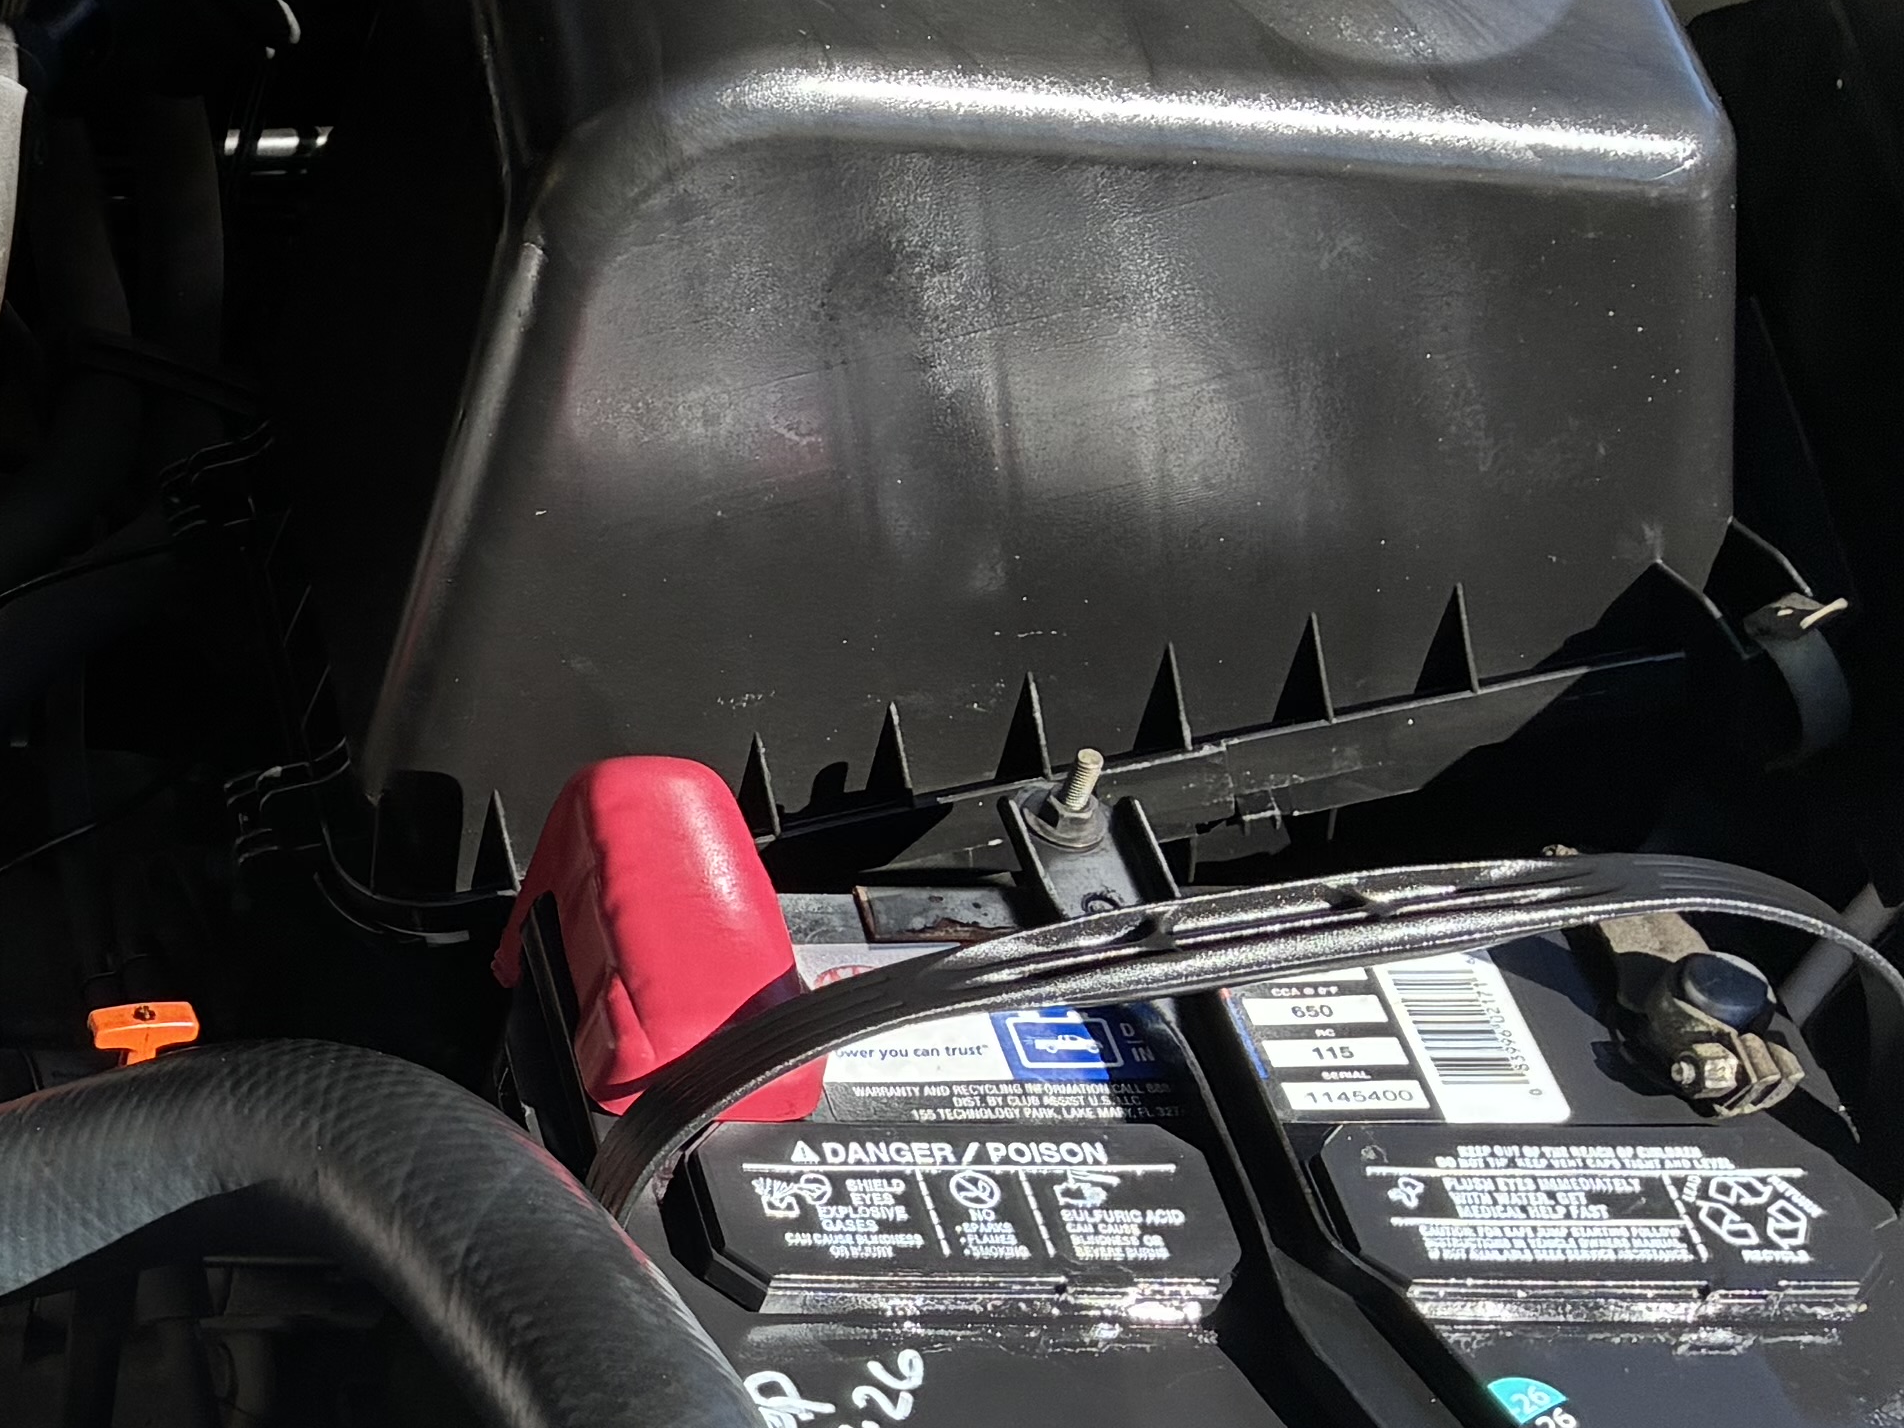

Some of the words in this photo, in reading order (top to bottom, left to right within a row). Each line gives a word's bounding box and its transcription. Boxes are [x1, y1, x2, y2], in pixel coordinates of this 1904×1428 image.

[1291, 1004, 1334, 1019] 650
[833, 1044, 876, 1061] ower
[879, 1045, 910, 1061] you
[913, 1047, 940, 1059] can
[1312, 1047, 1354, 1061] 115
[1321, 1070, 1372, 1081] SERIAL
[852, 1084, 920, 1098] WARRANTY
[923, 1084, 950, 1098] AND
[953, 1084, 1022, 1098] RECYCLING
[1025, 1084, 1109, 1098] INFORMATION
[1111, 1083, 1144, 1095] CALL
[1305, 1090, 1414, 1105] 1145400
[912, 1108, 935, 1120] 155
[938, 1108, 1021, 1120] TECHNOLOGY
[1024, 1108, 1058, 1120] PARK,
[1063, 1108, 1096, 1120] LAKE
[1138, 1107, 1152, 1118] FL
[821, 1142, 955, 1164] DANGER
[985, 1141, 1108, 1165] POISON
[845, 1178, 906, 1194] SHIELD
[1442, 1177, 1495, 1192] FLUSH
[1495, 1177, 1537, 1192] EYES
[1537, 1177, 1641, 1193] IMMEDIATELY
[850, 1192, 896, 1206] EYES
[1448, 1192, 1493, 1205] WITH
[1556, 1192, 1587, 1205] GET
[816, 1205, 910, 1221] EXPLOSIVE
[968, 1209, 996, 1222] NO
[1060, 1208, 1143, 1224] SULFURIC
[1146, 1208, 1186, 1226] ACID
[1456, 1205, 1528, 1219] MEDICAL
[1527, 1205, 1568, 1219] HELP
[1569, 1205, 1610, 1219] FAST
[821, 1219, 879, 1232] GASES
[1066, 1224, 1095, 1236] CAN
[1098, 1224, 1142, 1236] CAUSE
[784, 1233, 813, 1247] CAN
[813, 1233, 855, 1247] CAUSE
[856, 1233, 925, 1247] BLINDNESS
[1070, 1234, 1140, 1247] BLINDNESS
[1142, 1234, 1165, 1247] OR
[1510, 1386, 1551, 1415] -26
